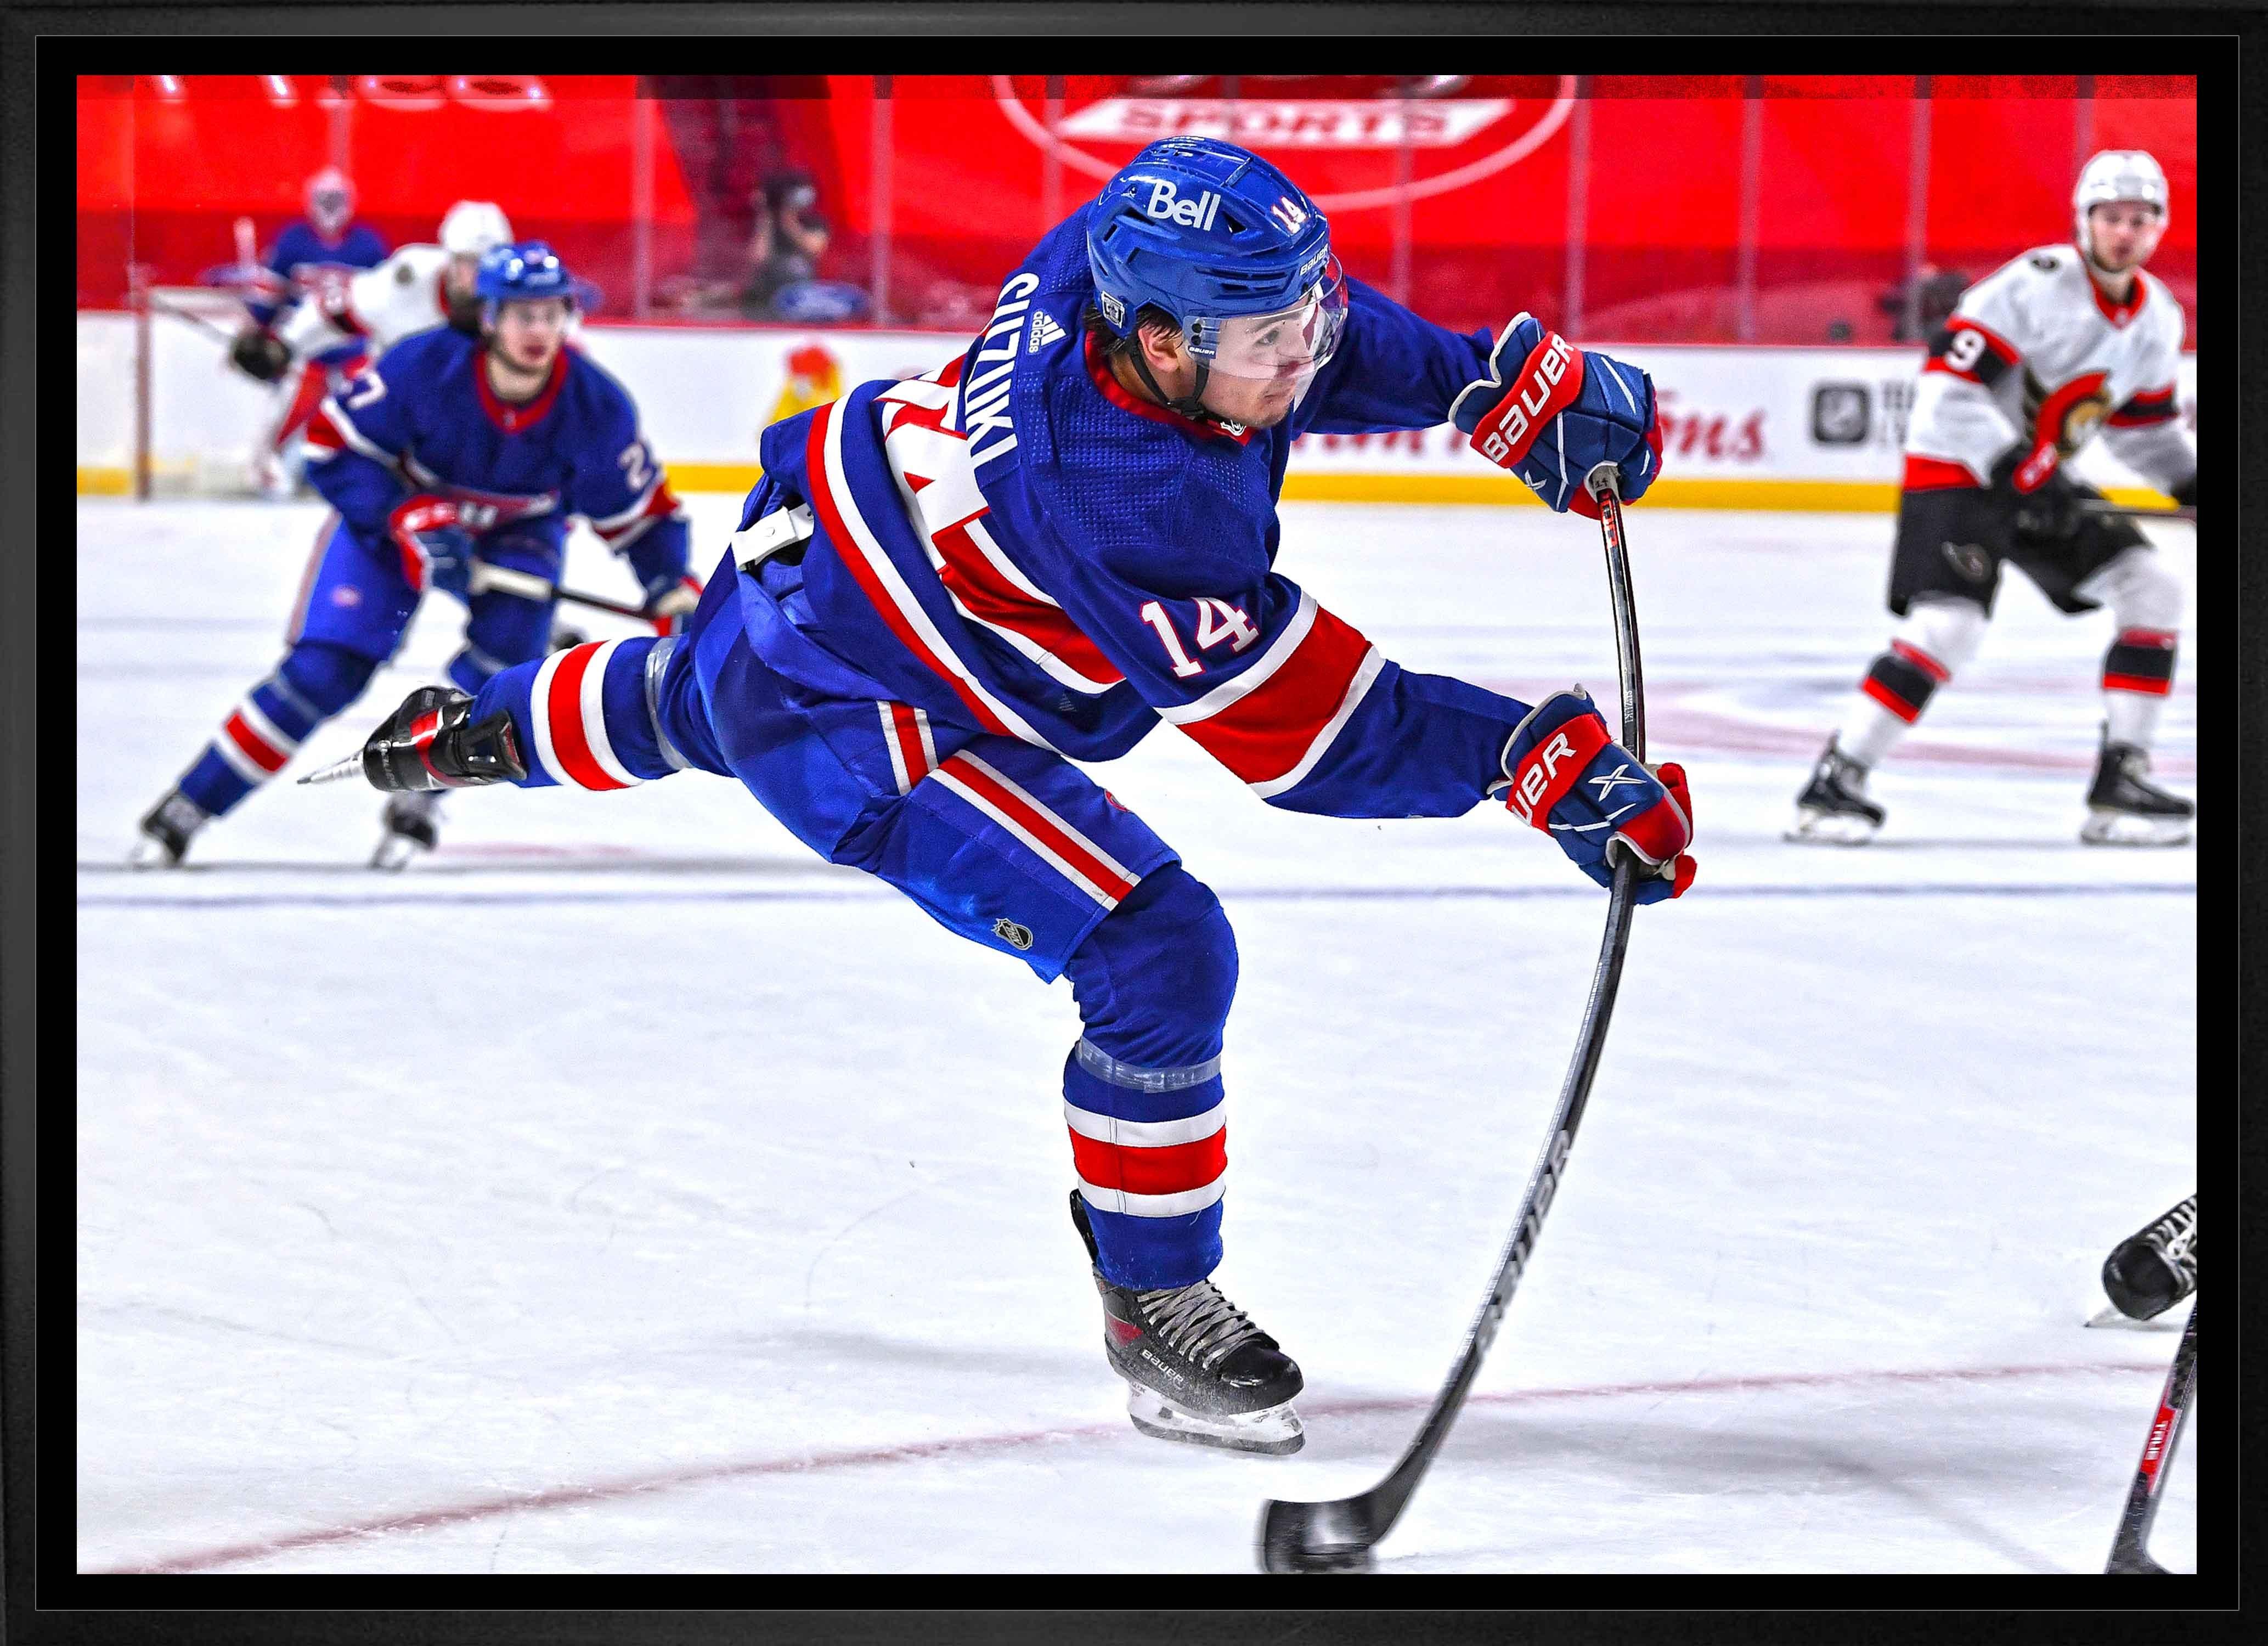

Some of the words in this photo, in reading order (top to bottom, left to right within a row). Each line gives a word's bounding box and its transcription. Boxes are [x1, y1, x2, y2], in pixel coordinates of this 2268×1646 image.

[1147, 179, 1221, 232] Bell
[1271, 195, 1307, 235] 14
[1299, 243, 1329, 277] BAUER
[1028, 310, 1044, 354] adidas
[1943, 329, 1987, 373] 9
[1481, 333, 1575, 463] BAUER
[1139, 596, 1260, 678] 14
[1624, 690, 1634, 724] SUZUKI
[1510, 732, 1577, 827] UER
[1142, 1349, 1184, 1384] BAUER
